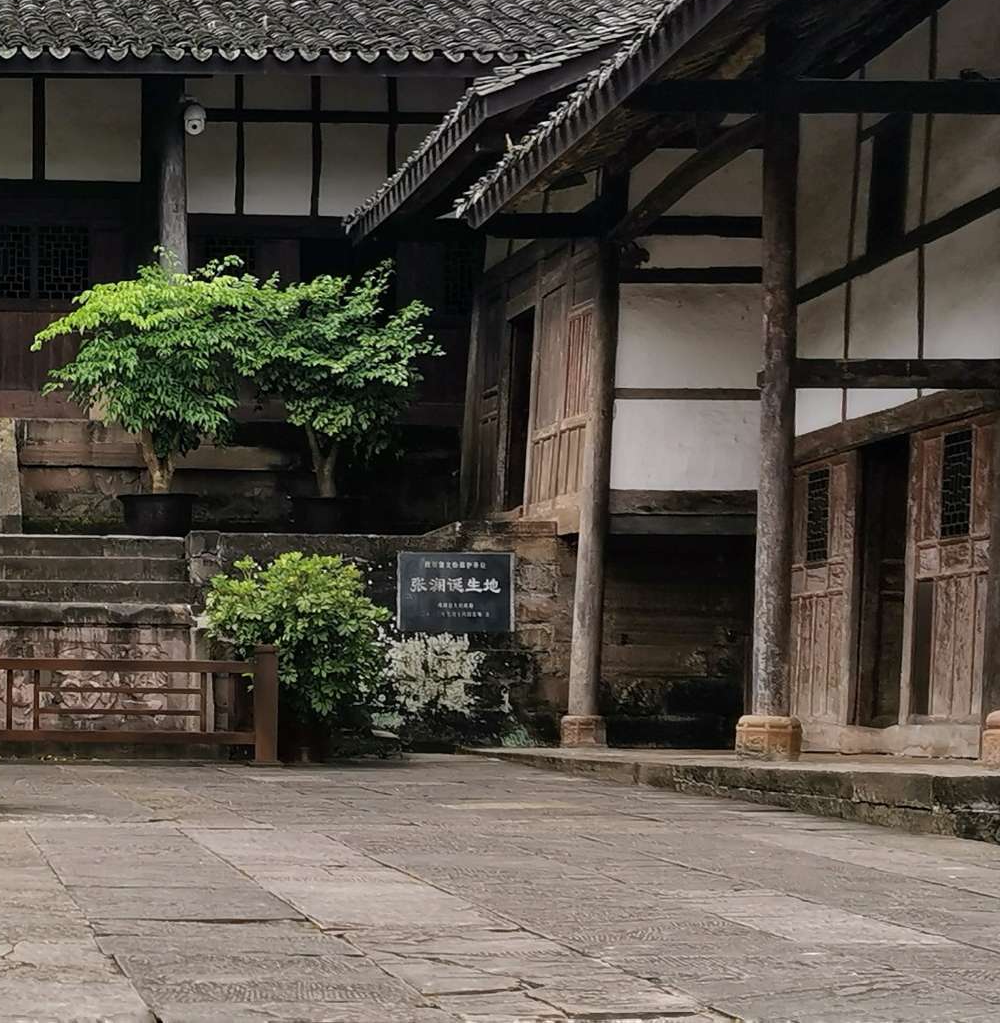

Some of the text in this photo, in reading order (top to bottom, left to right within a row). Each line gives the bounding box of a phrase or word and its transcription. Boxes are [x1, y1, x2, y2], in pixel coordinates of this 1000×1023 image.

[410, 576, 501, 594] 张澜诞生地
